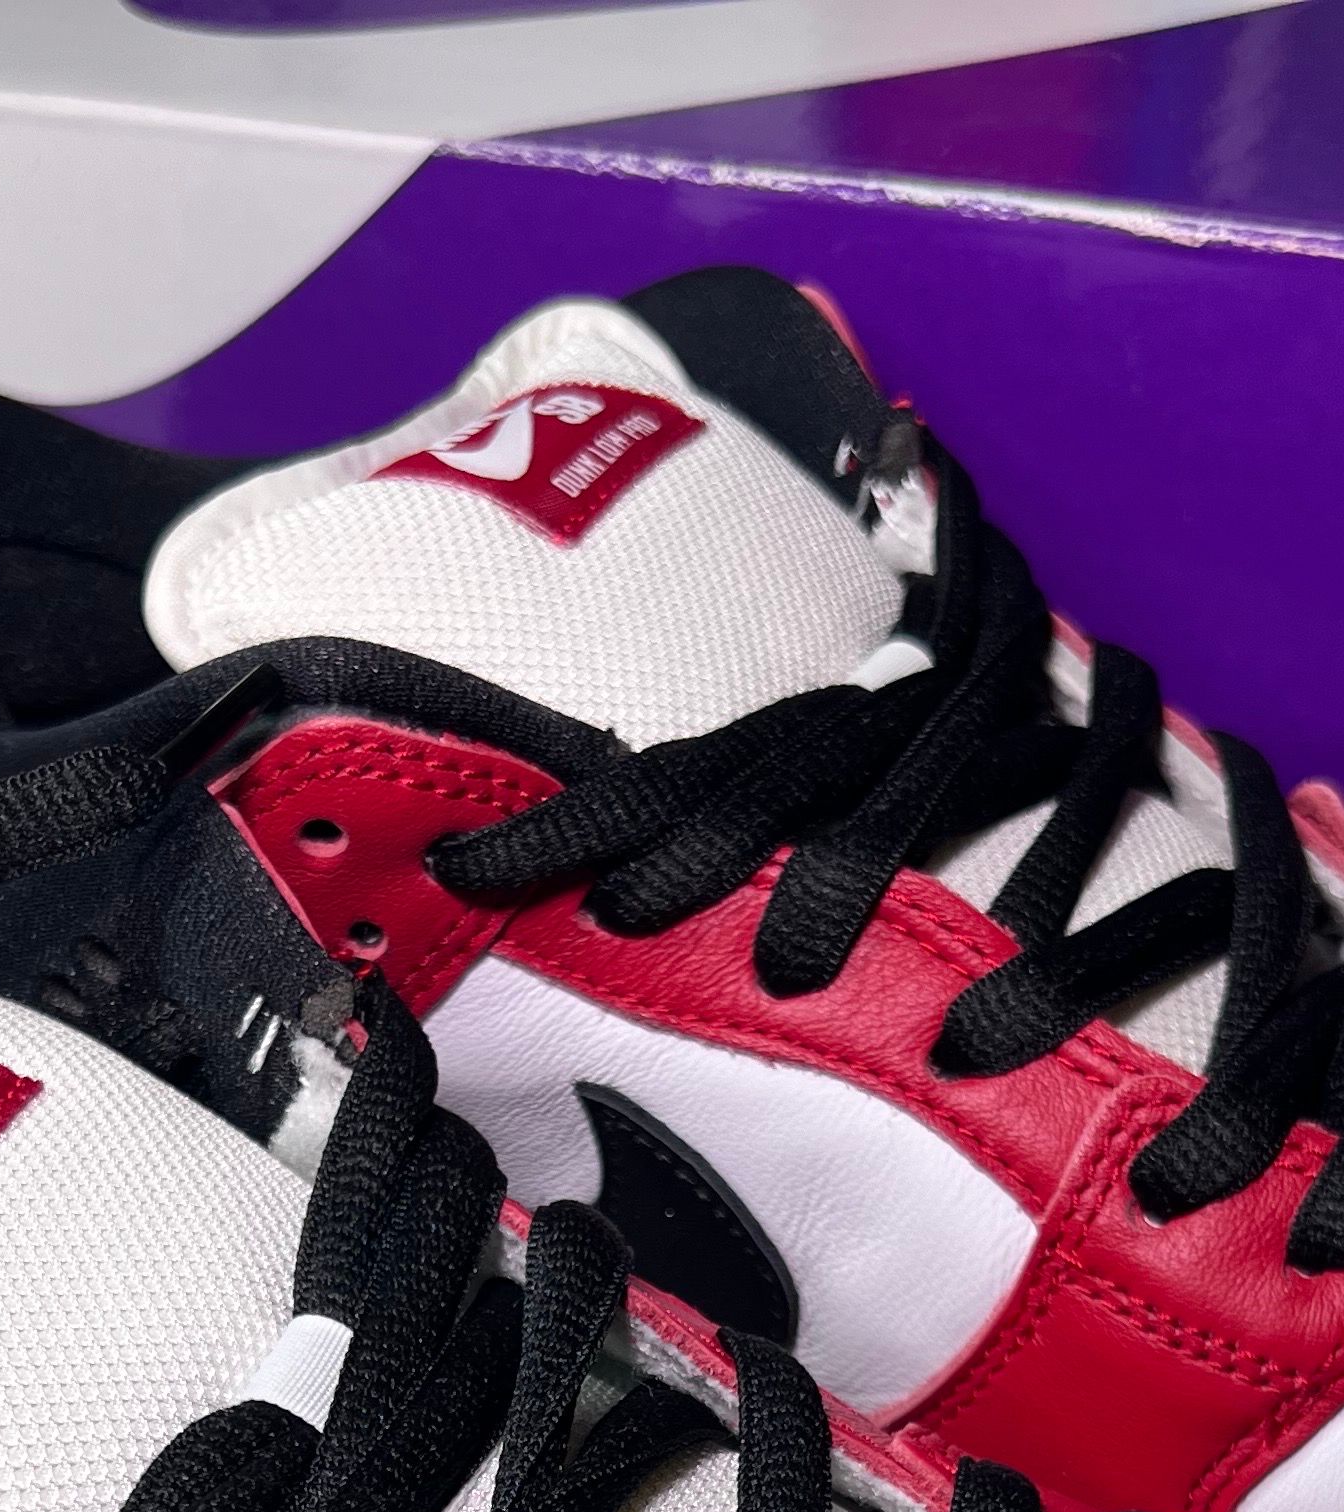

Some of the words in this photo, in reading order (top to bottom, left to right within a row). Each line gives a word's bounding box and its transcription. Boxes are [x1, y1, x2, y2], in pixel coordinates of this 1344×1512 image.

[531, 394, 605, 425] SB
[549, 450, 610, 499] DUNK
[584, 428, 634, 466] LOW
[615, 411, 663, 441] PRO
